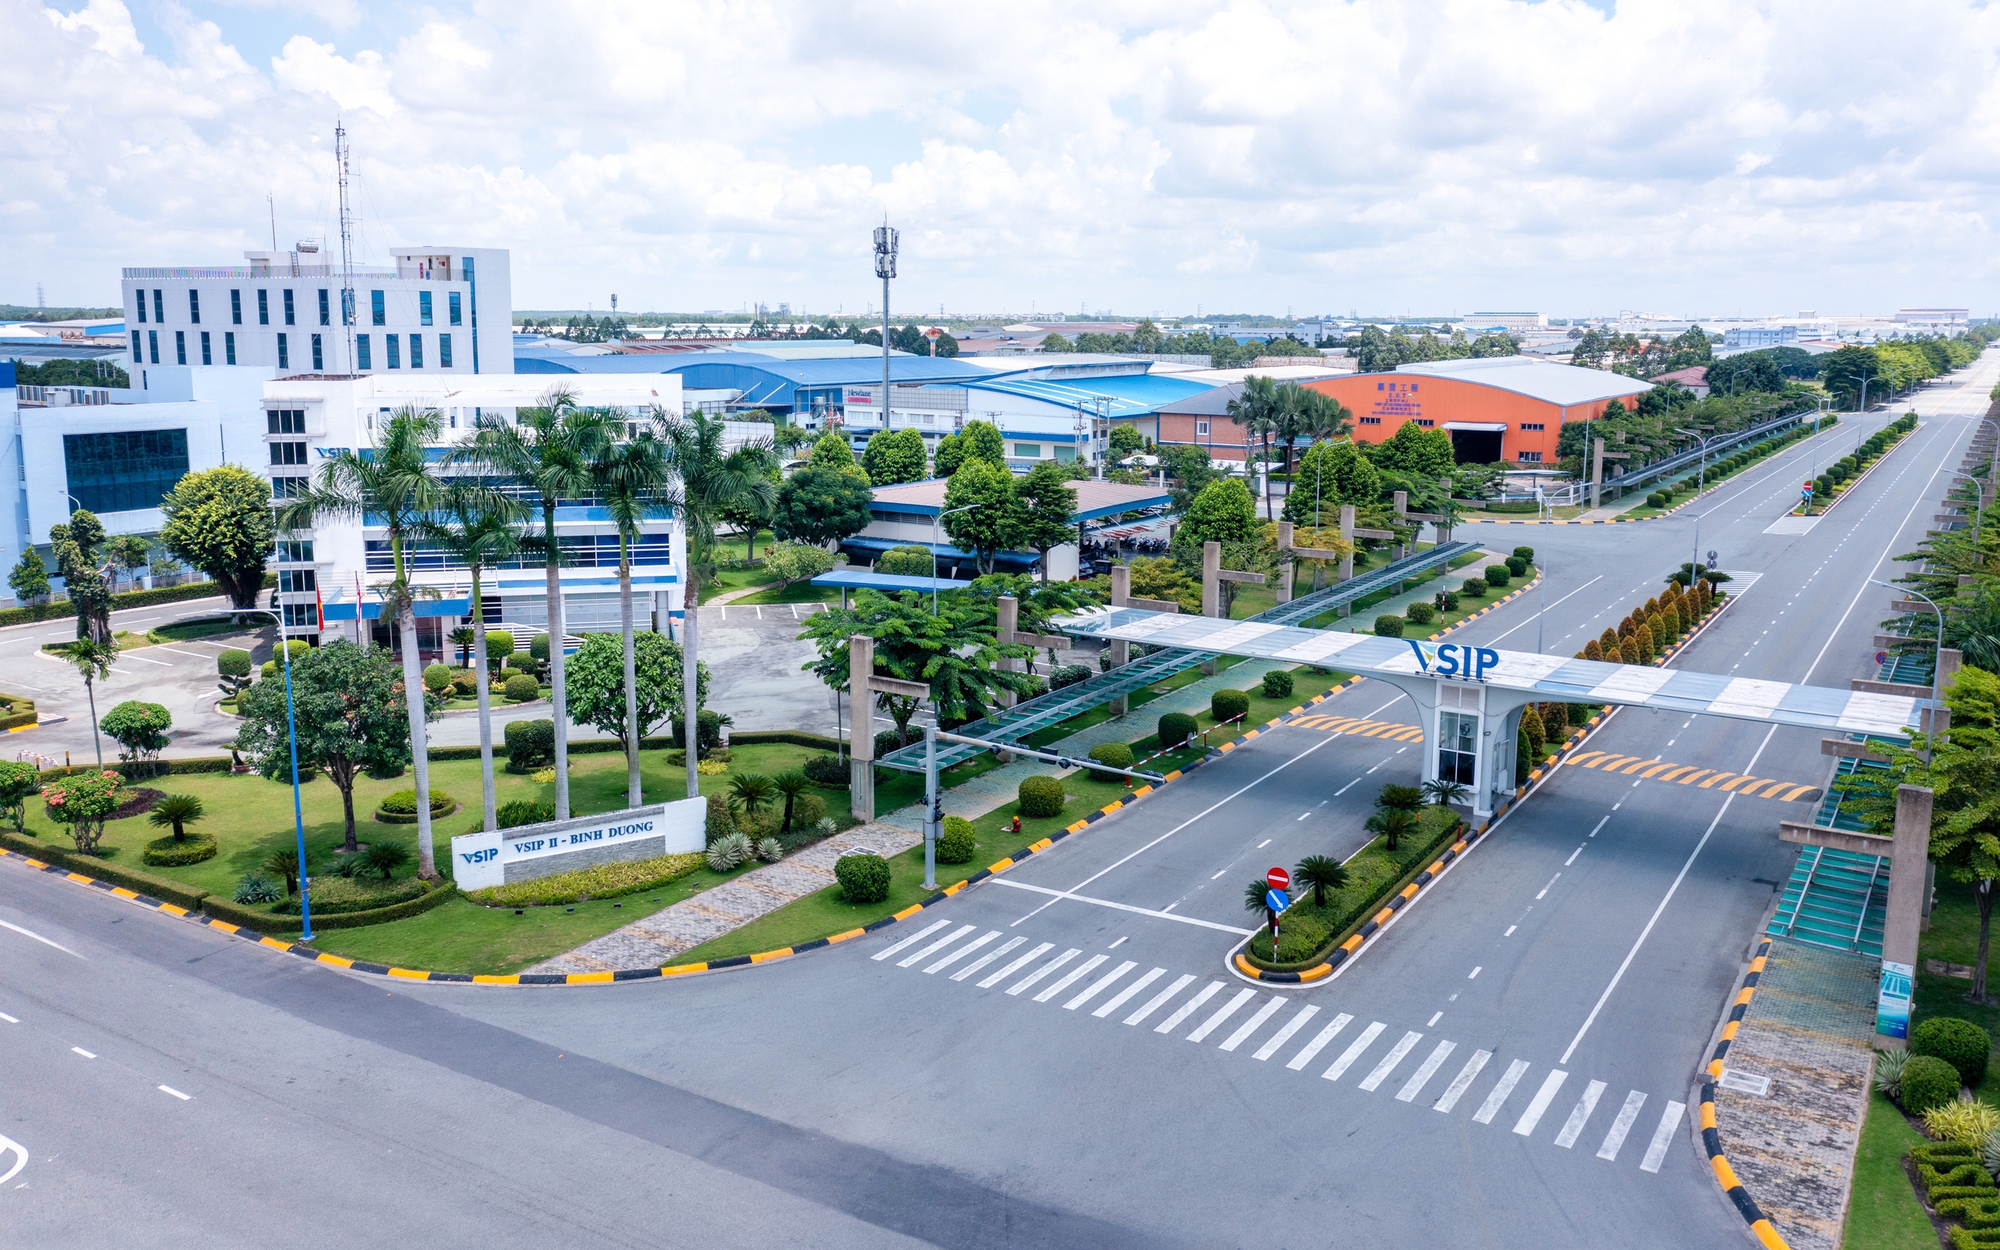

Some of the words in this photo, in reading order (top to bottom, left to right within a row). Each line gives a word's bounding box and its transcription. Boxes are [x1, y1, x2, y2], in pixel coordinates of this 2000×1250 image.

[1401, 638, 1499, 680] VSIP
[514, 840, 545, 853] VSIP
[549, 836, 559, 848] II
[570, 829, 603, 845] BINH
[608, 821, 654, 838] DUONG
[459, 848, 499, 864] VSIP
